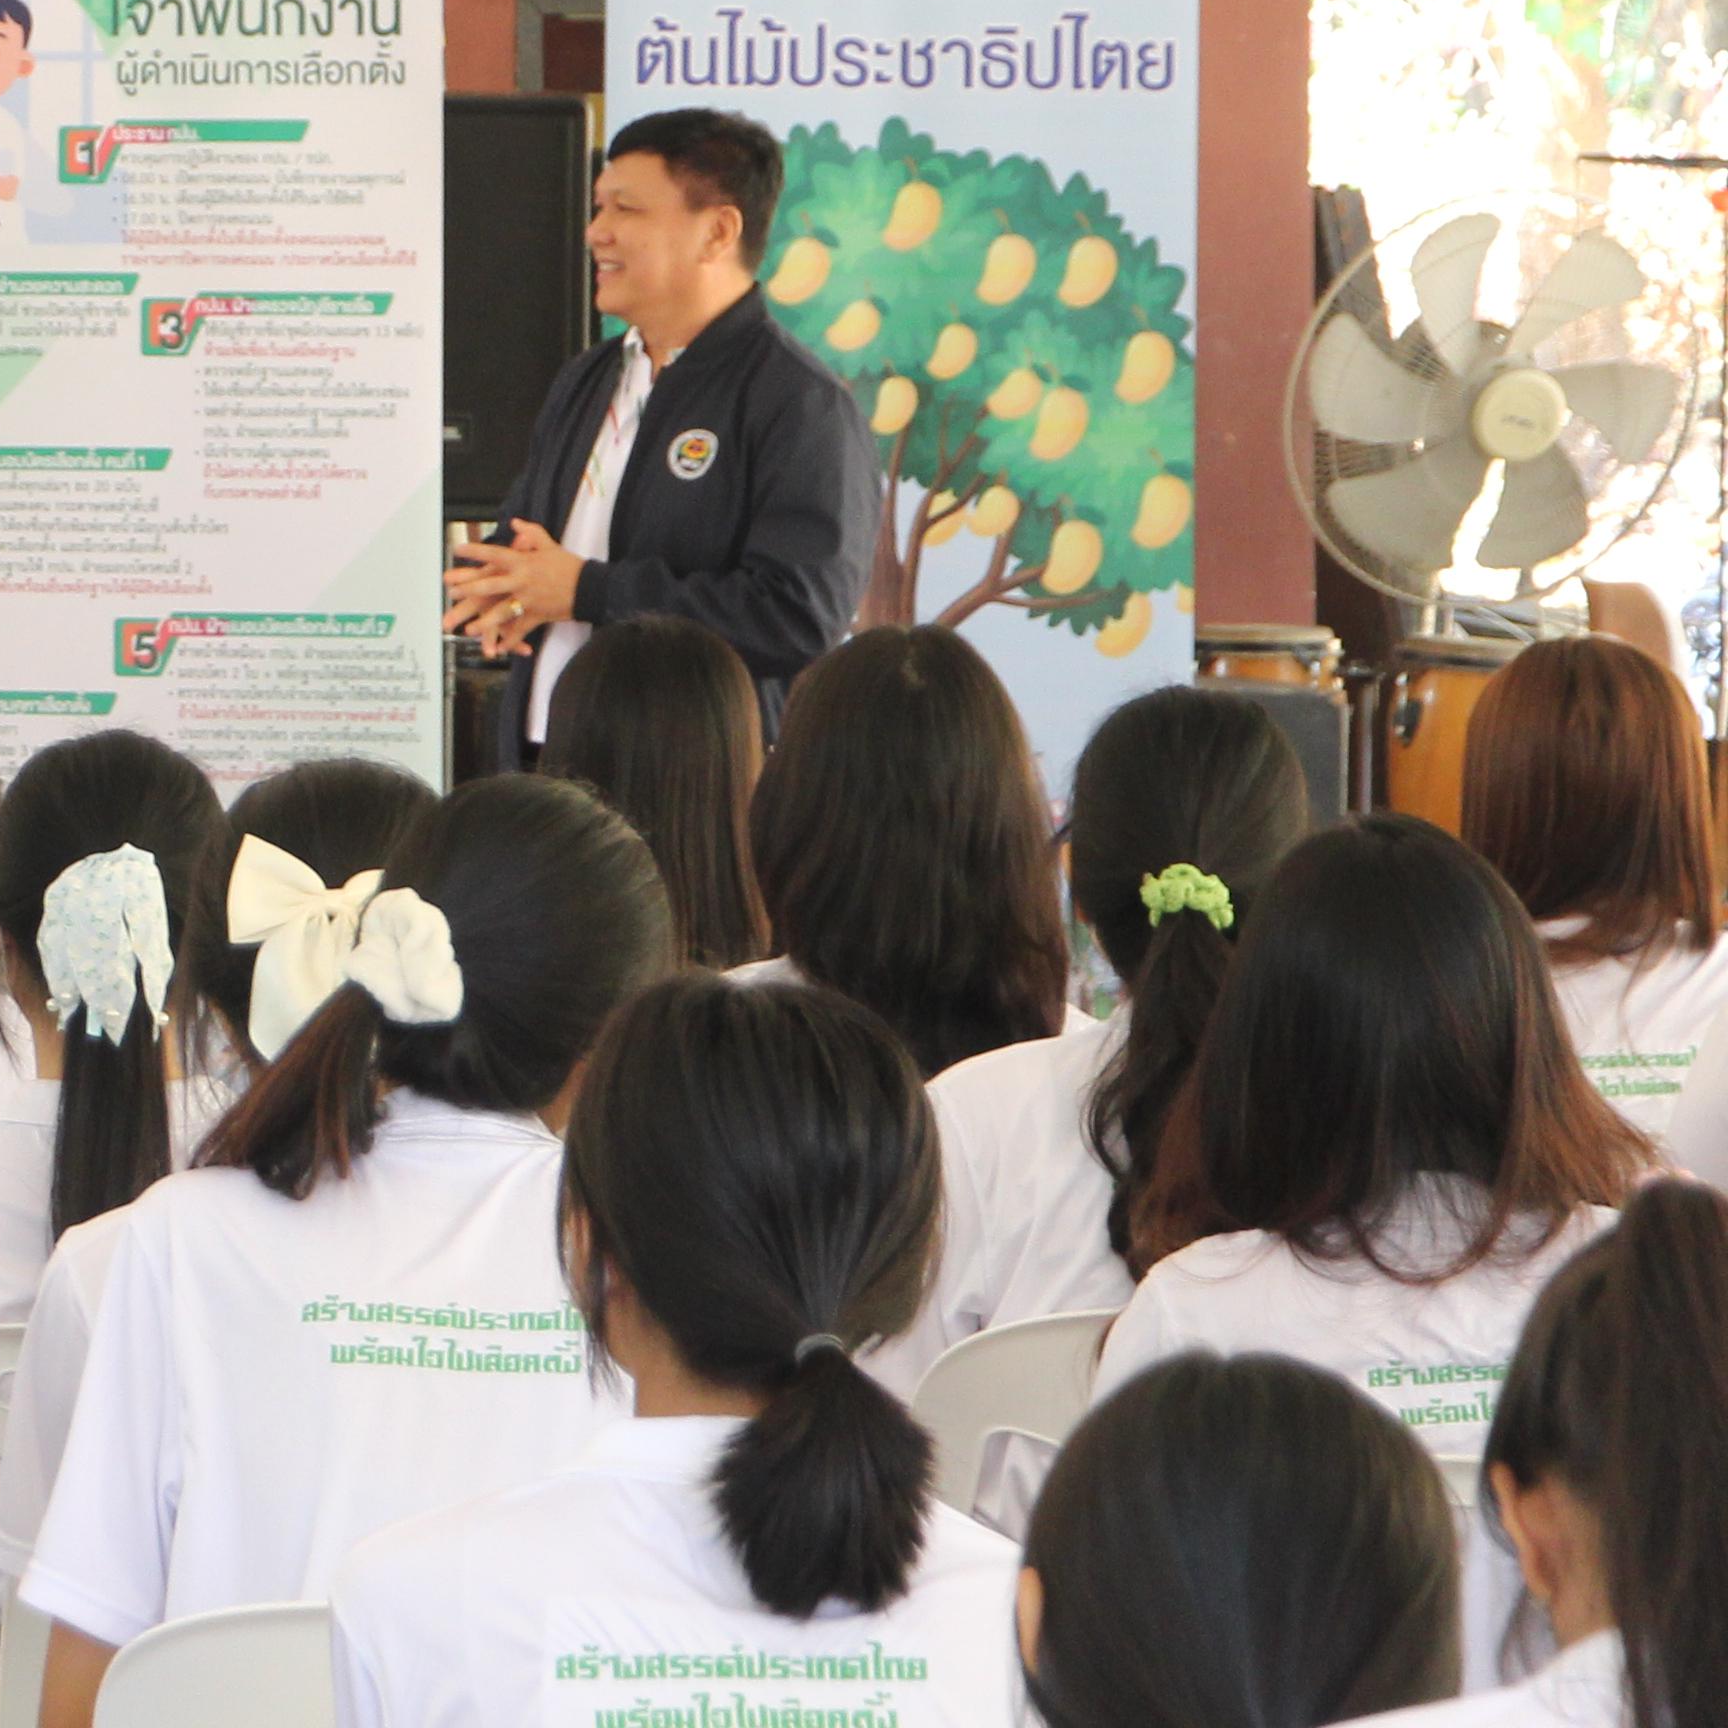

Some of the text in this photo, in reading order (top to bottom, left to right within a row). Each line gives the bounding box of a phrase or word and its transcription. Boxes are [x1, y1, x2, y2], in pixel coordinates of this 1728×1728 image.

[116, 41, 406, 97] ผู้ดำเนินการเลือกตั้ง
[635, 9, 1175, 91] ต้นไม้ประชาธิปไตย
[159, 312, 185, 350] 3
[132, 631, 159, 669] 5
